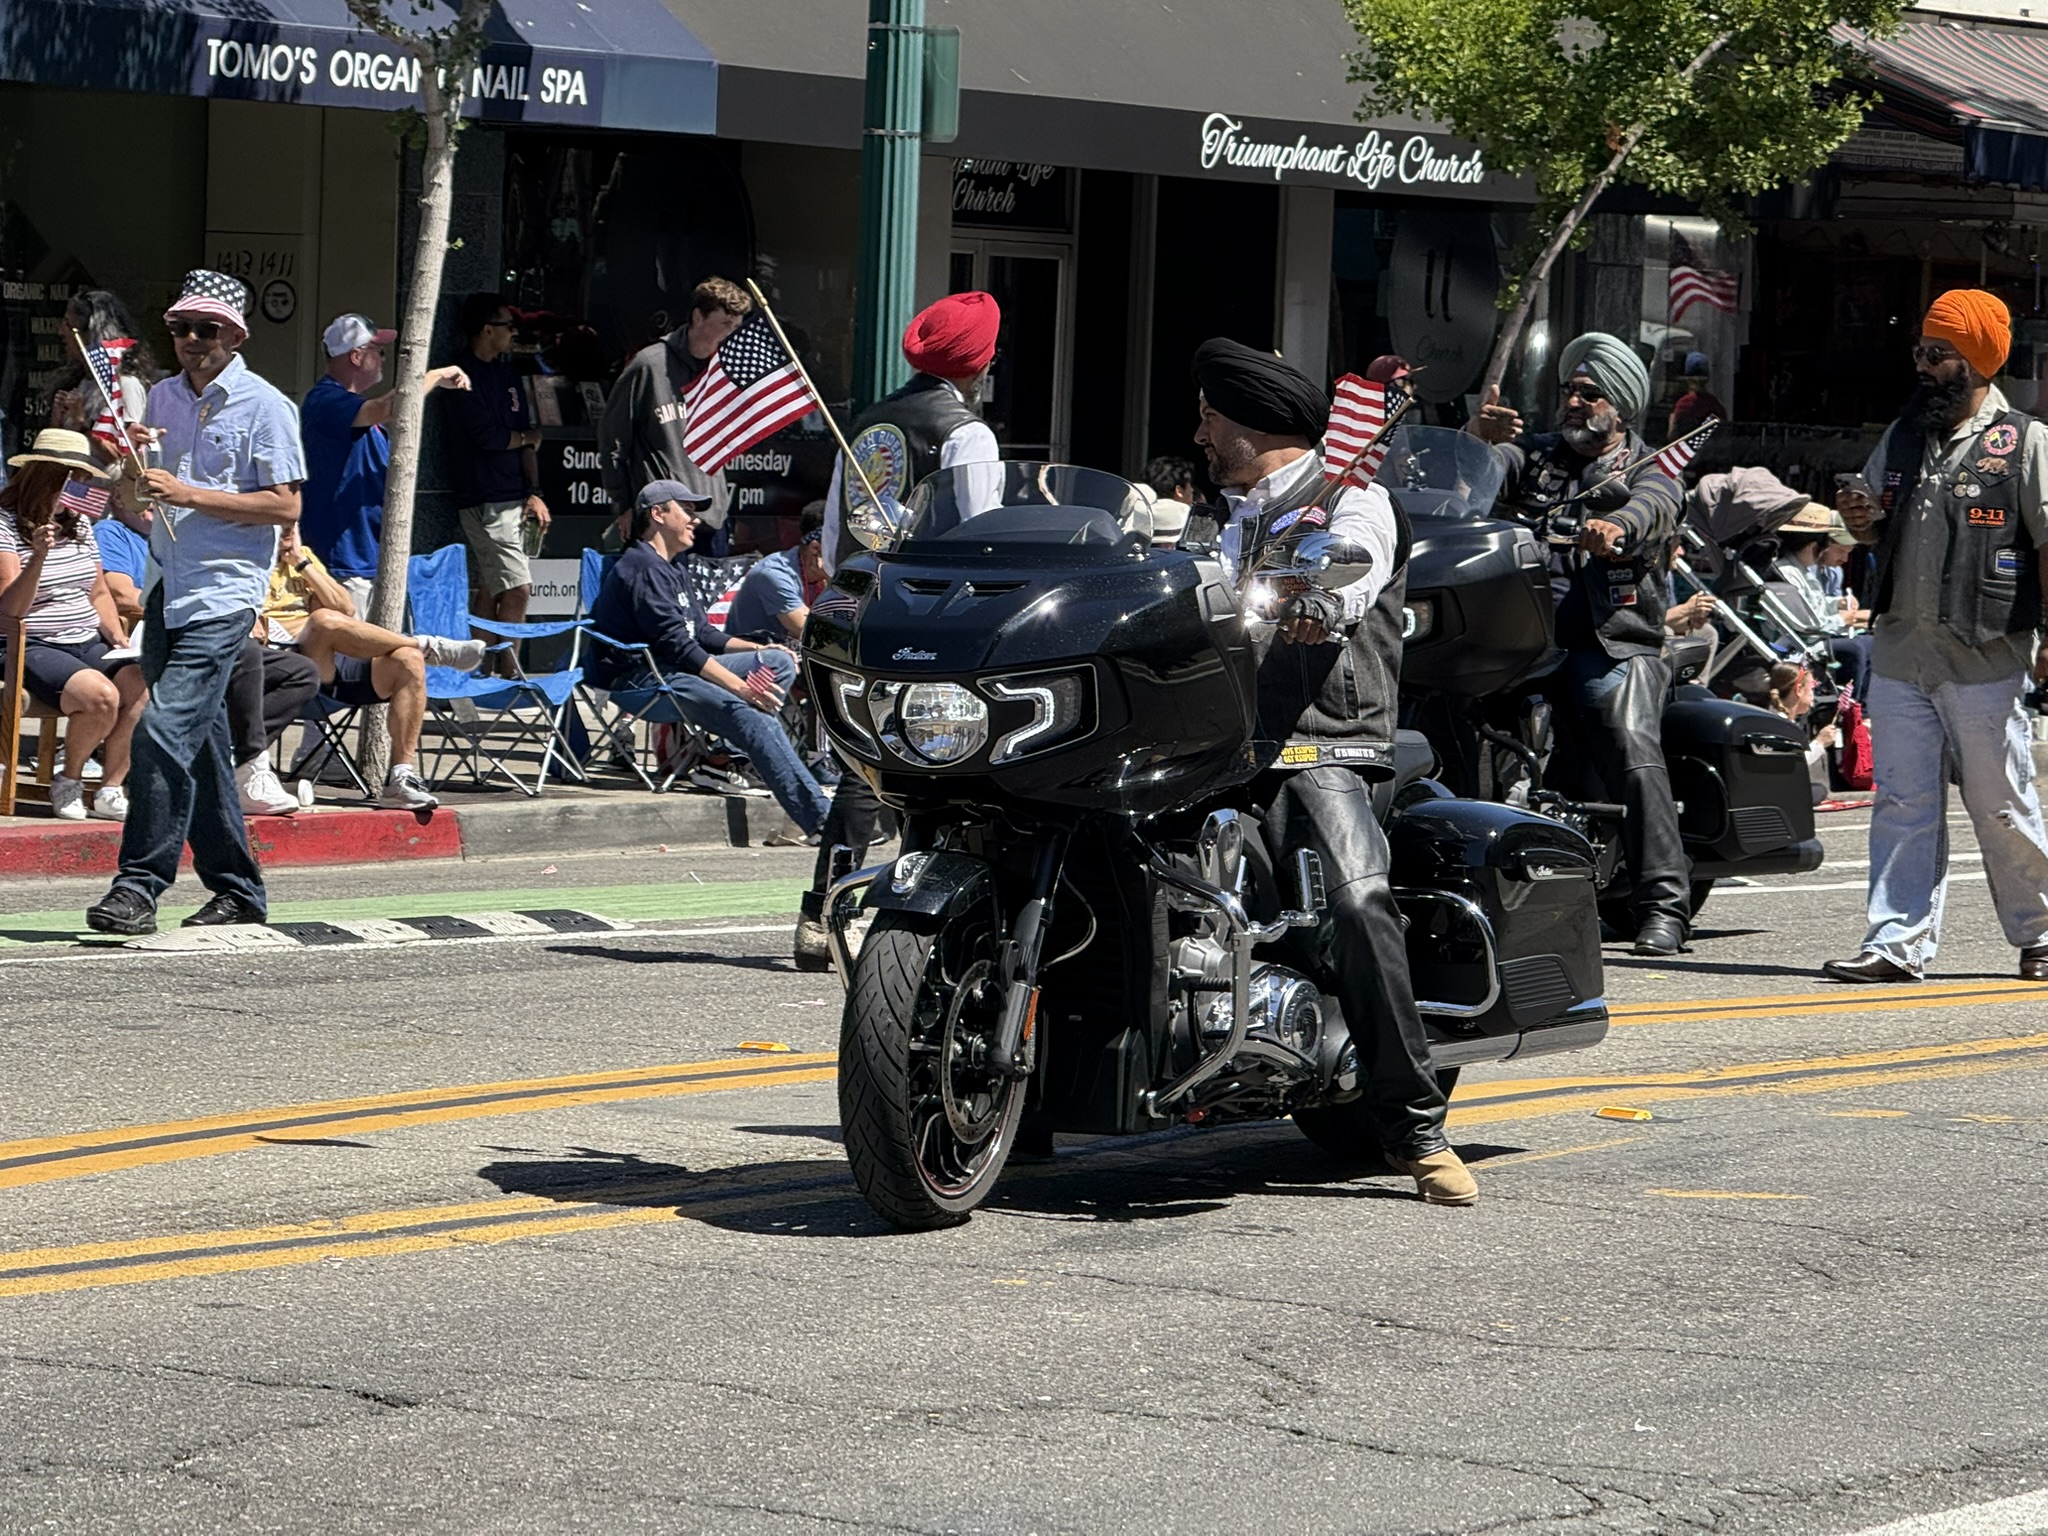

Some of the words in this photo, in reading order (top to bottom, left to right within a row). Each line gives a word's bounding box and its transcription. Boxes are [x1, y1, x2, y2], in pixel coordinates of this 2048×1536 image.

[207, 38, 318, 84] TOMO'S
[329, 49, 447, 93] ORGAN
[472, 64, 530, 100] NAIL
[540, 67, 588, 105] SPA
[1202, 112, 1349, 181] Triumphant
[1347, 130, 1397, 190] Life
[1399, 135, 1485, 184] Church
[953, 178, 1016, 213] Church
[260, 252, 294, 277] 1411
[3, 281, 44, 300] ORGANIC
[49, 283, 69, 300] NAIL
[654, 403, 678, 424] SAN
[563, 446, 602, 469] Sun
[879, 430, 904, 469] RIDERS
[725, 450, 793, 477] nesday
[568, 482, 588, 504] 10
[739, 486, 764, 509] pm
[1969, 507, 2005, 520] 9-11
